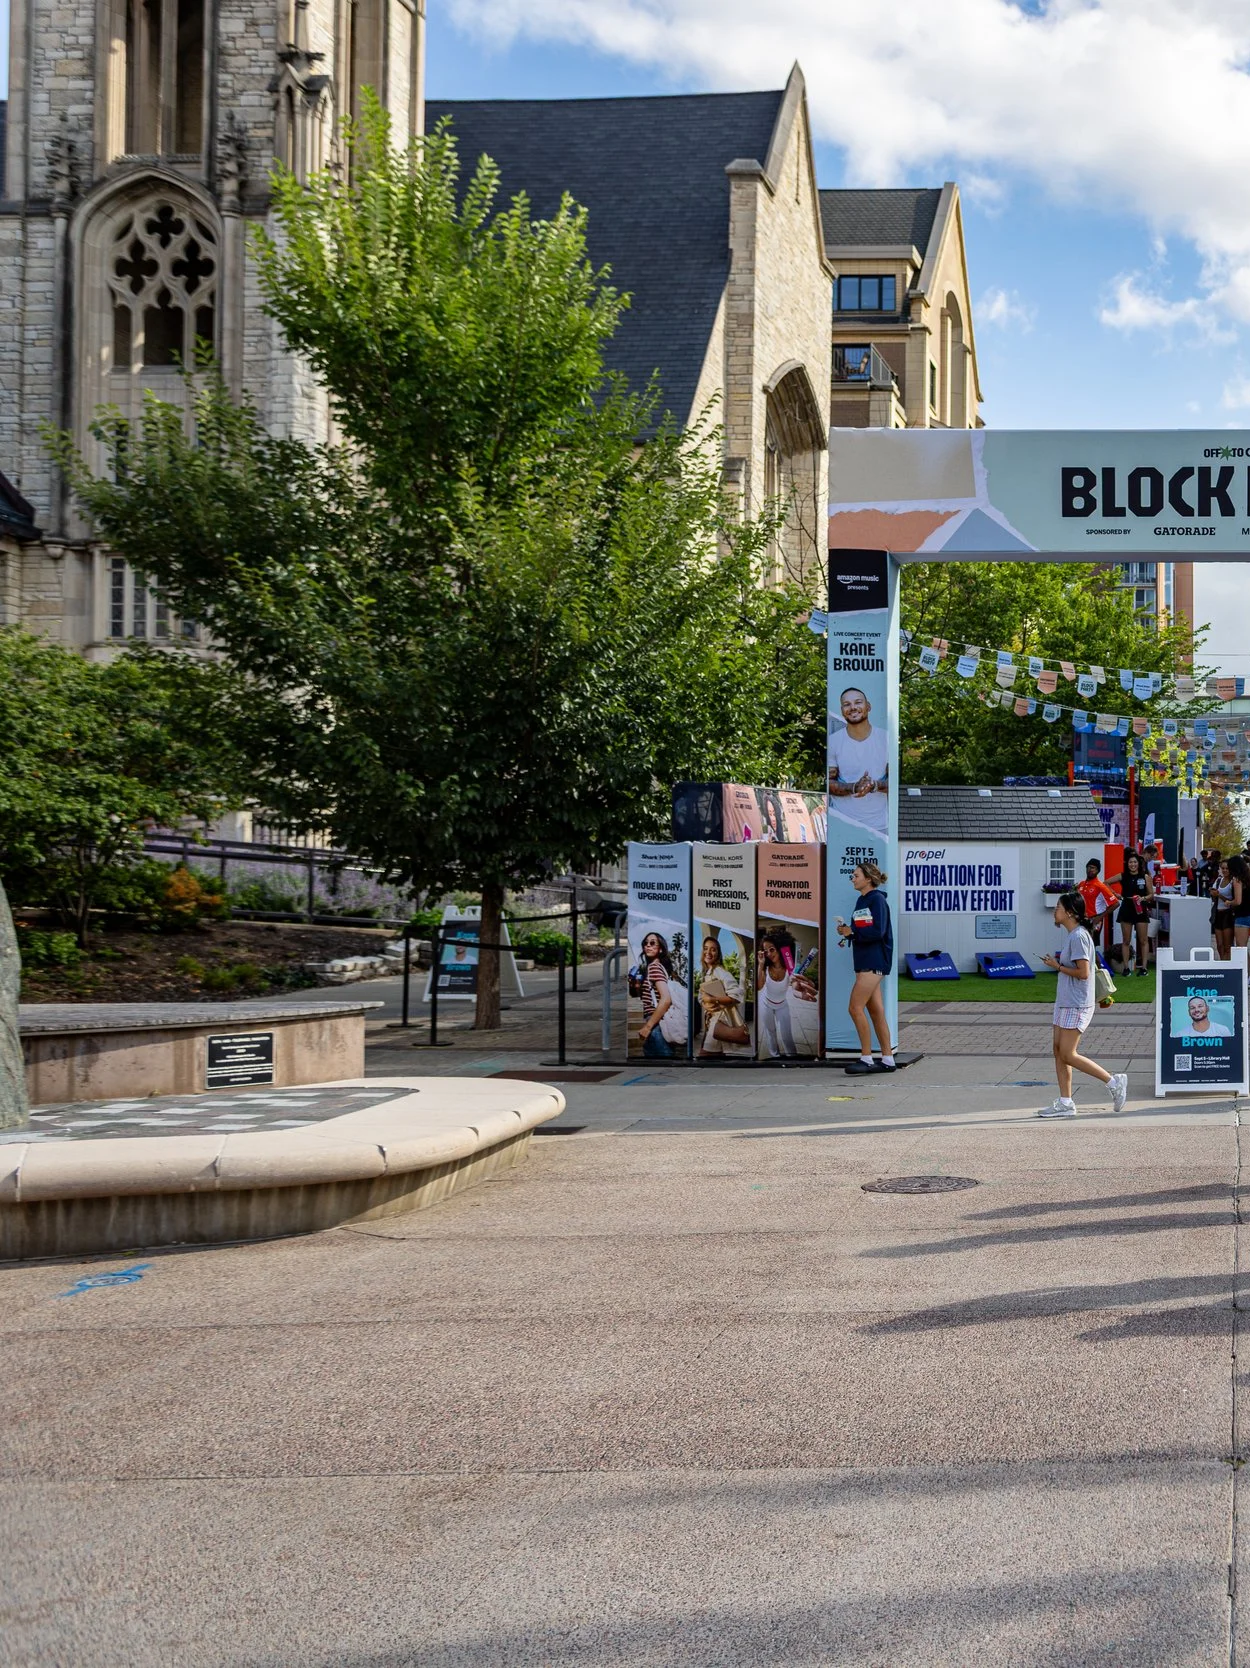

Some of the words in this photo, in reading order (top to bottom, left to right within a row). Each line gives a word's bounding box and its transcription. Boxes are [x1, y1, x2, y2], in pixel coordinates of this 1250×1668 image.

[1204, 448, 1220, 458] OFF
[1232, 448, 1244, 458] TO
[1061, 466, 1236, 518] BLOCK
[1154, 527, 1216, 536] GATORADE
[837, 575, 860, 583] amazon
[840, 642, 875, 656] KANE
[834, 658, 884, 672] BROWN
[846, 847, 866, 856] SEPT
[868, 848, 874, 856] 5
[906, 849, 946, 861] propel
[841, 857, 861, 865] 7:30
[905, 865, 976, 886] HYDRATION
[978, 865, 1002, 886] FOR
[665, 883, 682, 892] DAY,
[712, 879, 732, 887] FIRST
[767, 880, 809, 888] HYDRATION
[638, 892, 677, 901] UPGRADED
[698, 889, 749, 901] IMPRESSIONS,
[781, 891, 796, 899] DAY
[706, 900, 740, 910] HANDLED
[905, 890, 968, 911] EVERYDAY
[971, 890, 1014, 911] EFFORT
[915, 965, 952, 974] propel
[989, 964, 1024, 973] propel
[1187, 987, 1218, 997] Kane
[1182, 1036, 1222, 1047] Brown
